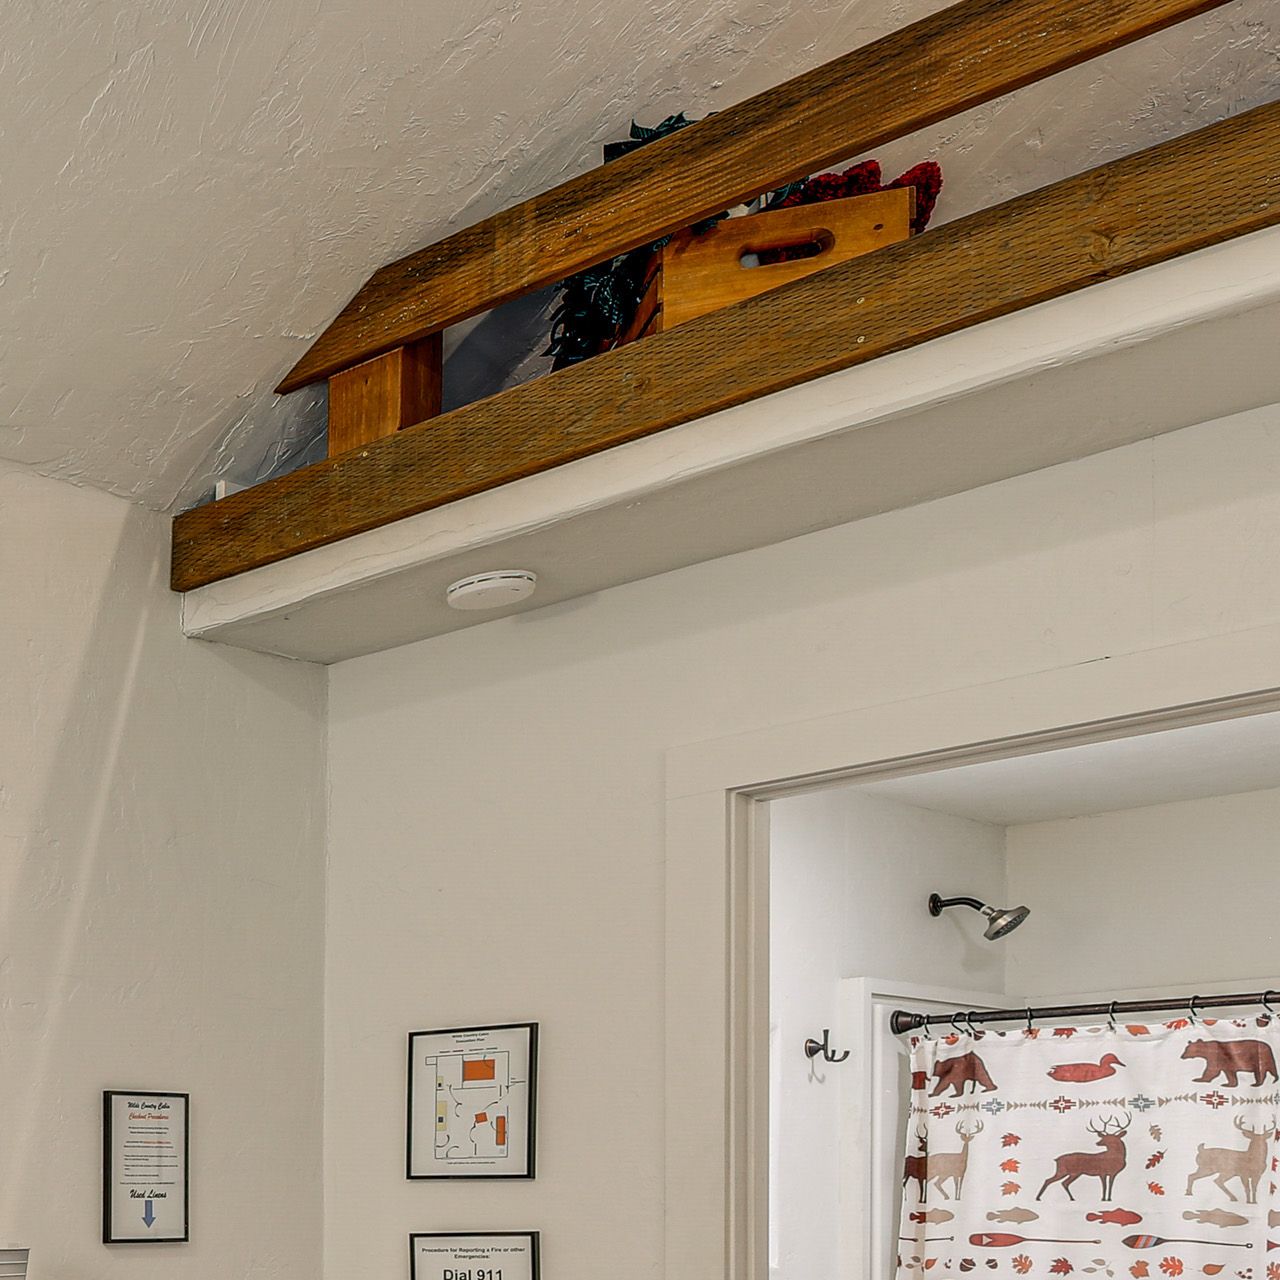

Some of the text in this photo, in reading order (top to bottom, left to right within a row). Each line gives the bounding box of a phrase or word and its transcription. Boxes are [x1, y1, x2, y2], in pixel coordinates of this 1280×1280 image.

[129, 1189, 168, 1199] Used Linens
[443, 1269, 503, 1280] Dial 911
